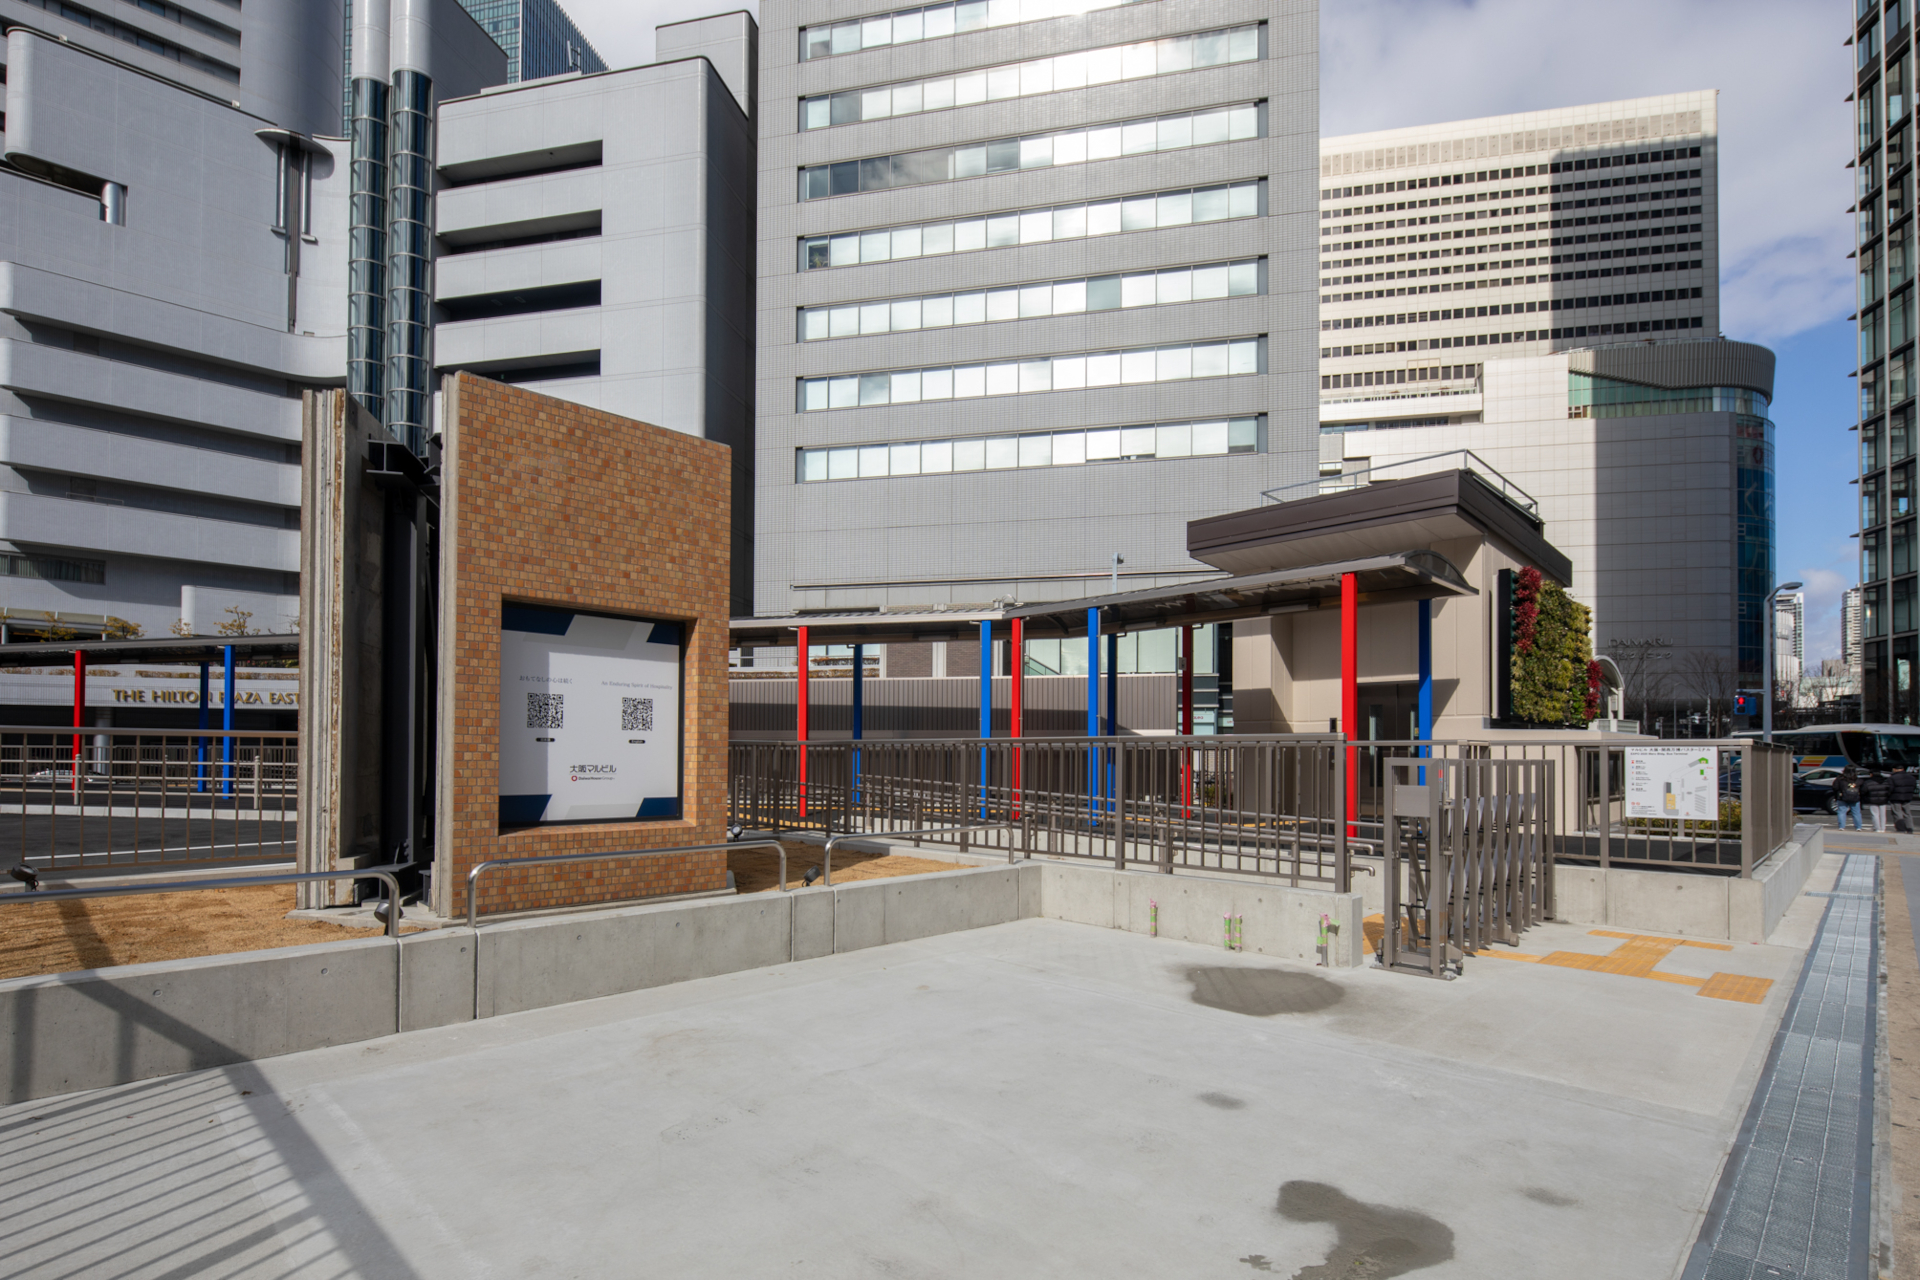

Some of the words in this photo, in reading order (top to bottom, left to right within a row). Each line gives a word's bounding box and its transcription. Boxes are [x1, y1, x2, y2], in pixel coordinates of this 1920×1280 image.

[1608, 638, 1673, 647] DAIMARU
[609, 680, 630, 688] Enduring
[113, 689, 146, 703] THE
[151, 689, 213, 704] HILTO
[219, 690, 263, 704] PAZA
[269, 691, 300, 704] EAST
[569, 764, 617, 773] 大阪マルビル
